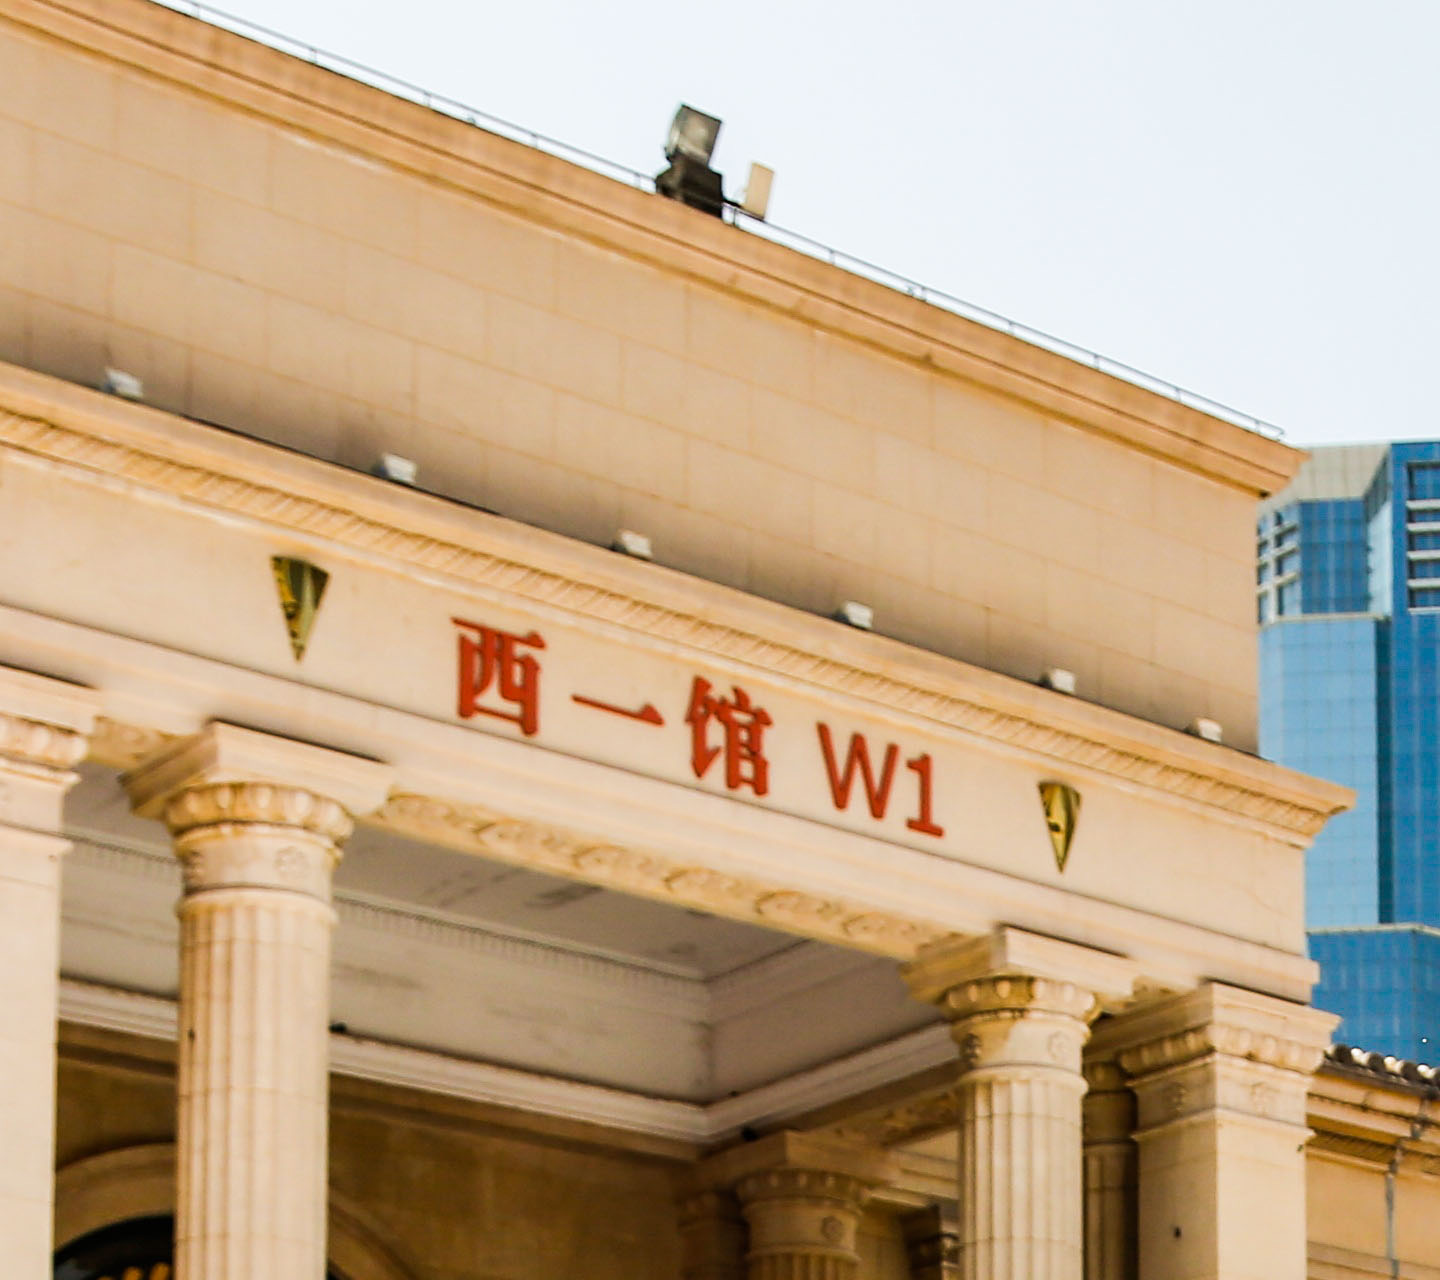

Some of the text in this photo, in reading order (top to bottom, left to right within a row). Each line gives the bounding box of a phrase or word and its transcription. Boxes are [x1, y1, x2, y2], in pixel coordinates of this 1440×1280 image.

[451, 617, 944, 837] 西一馆 W1
